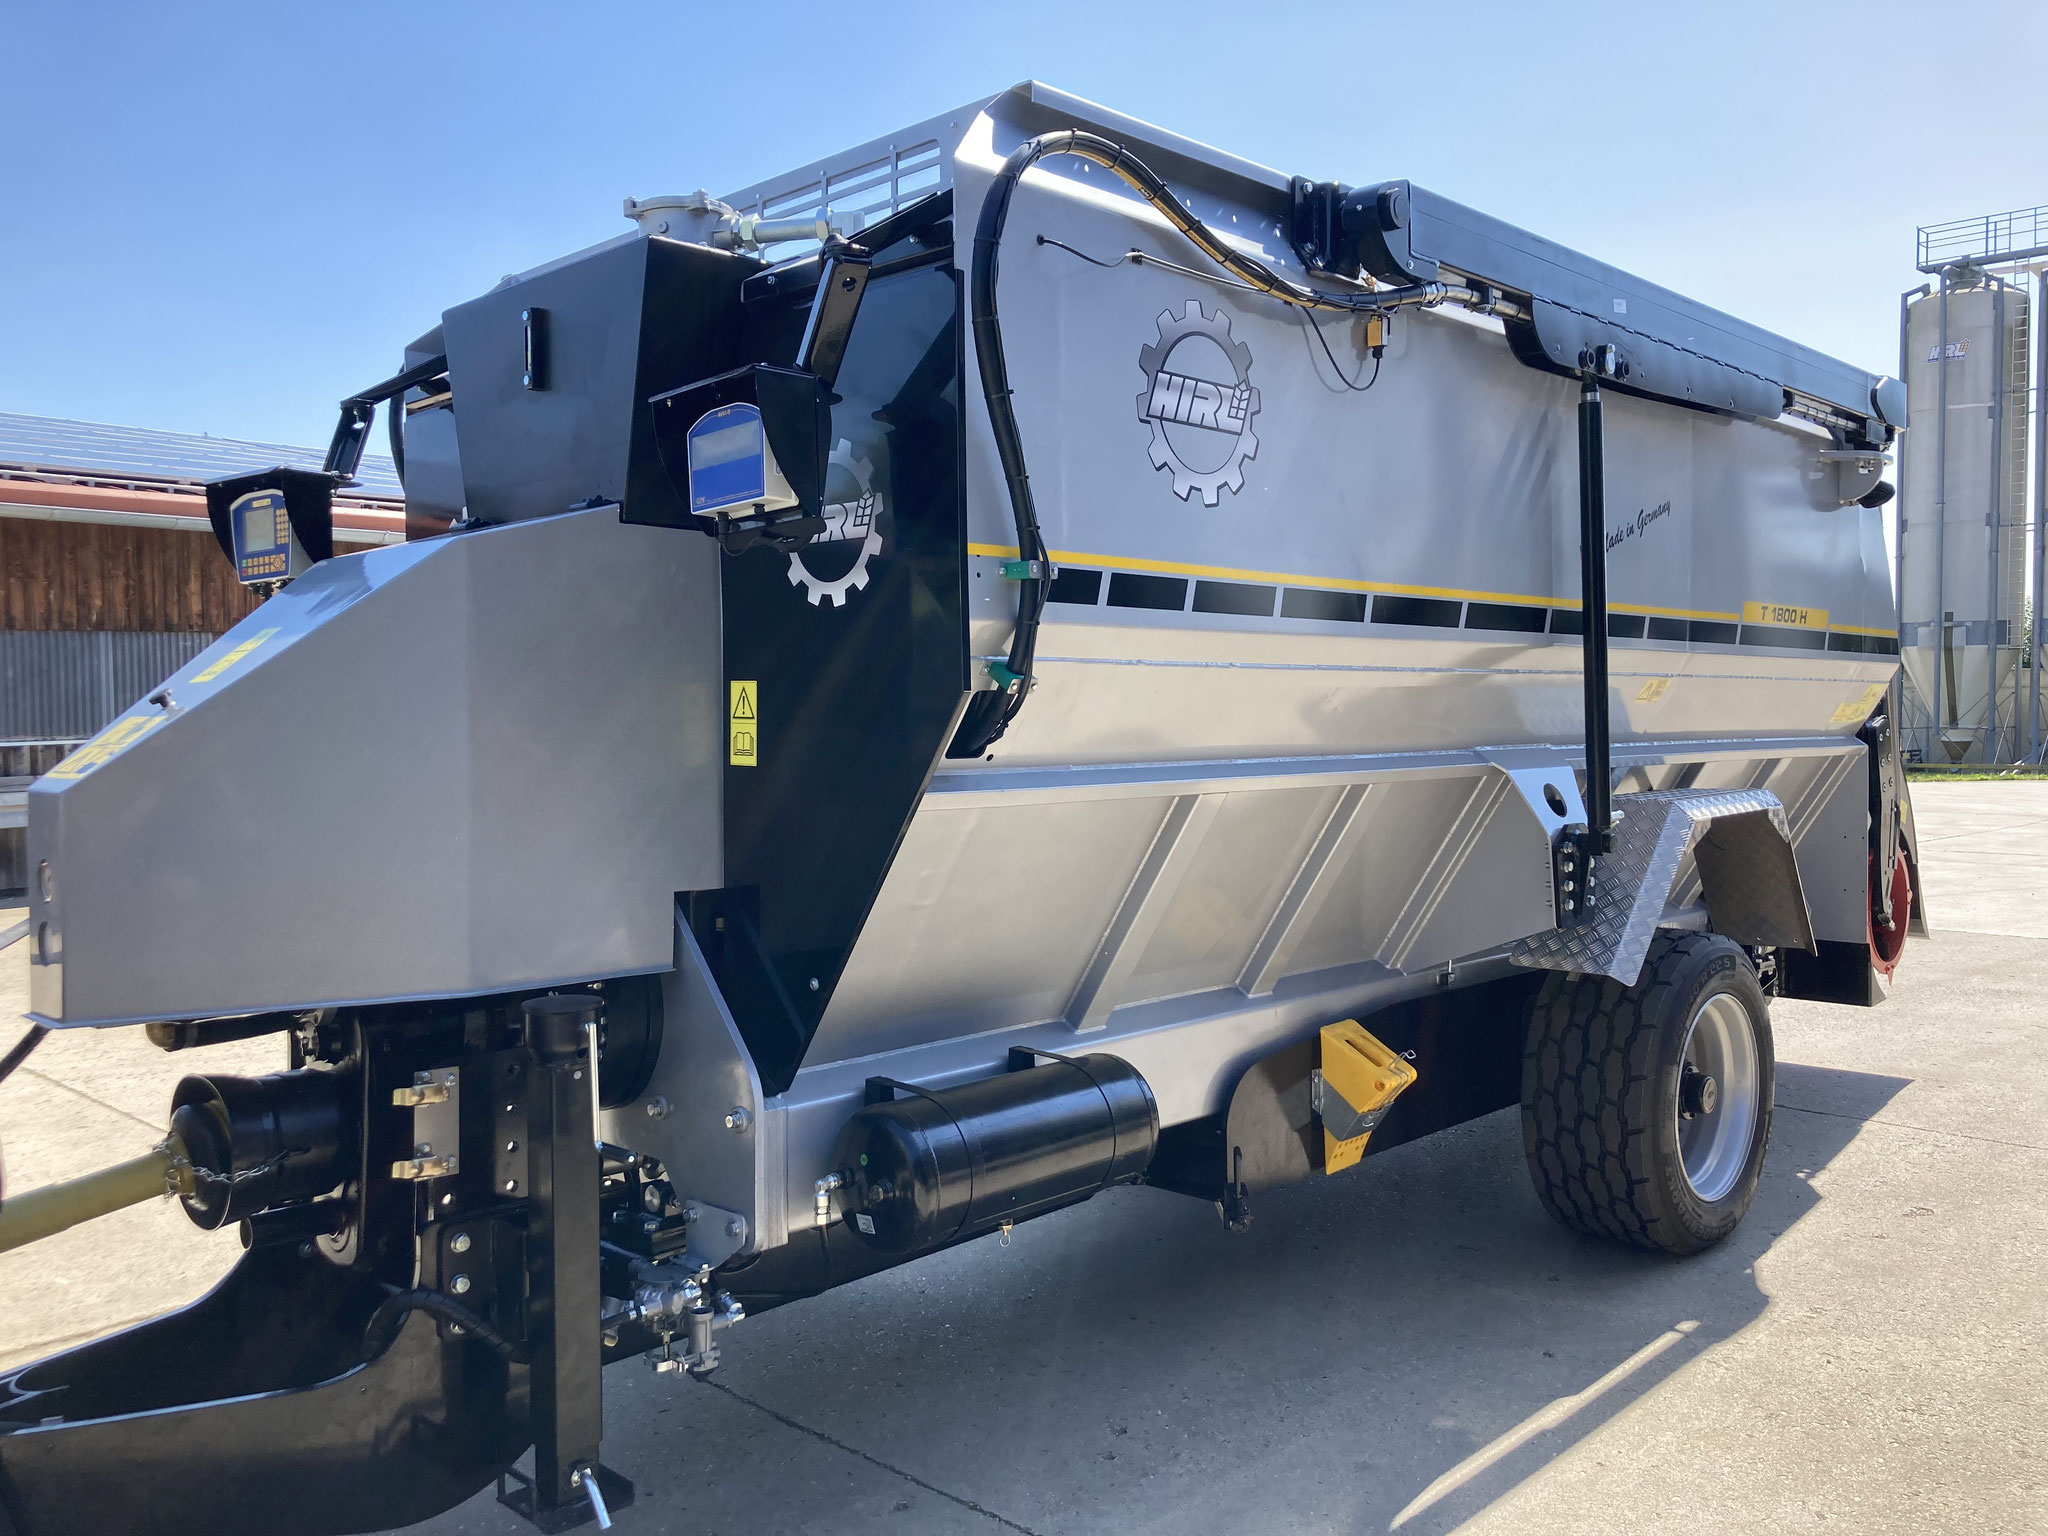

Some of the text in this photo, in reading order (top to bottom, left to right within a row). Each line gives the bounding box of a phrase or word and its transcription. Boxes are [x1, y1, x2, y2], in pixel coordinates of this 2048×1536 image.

[1927, 342, 1967, 362] HRL
[1147, 370, 1249, 435] HIRL
[1605, 501, 1671, 553] ade in Germany
[1761, 605, 1808, 625] T 1800 H
